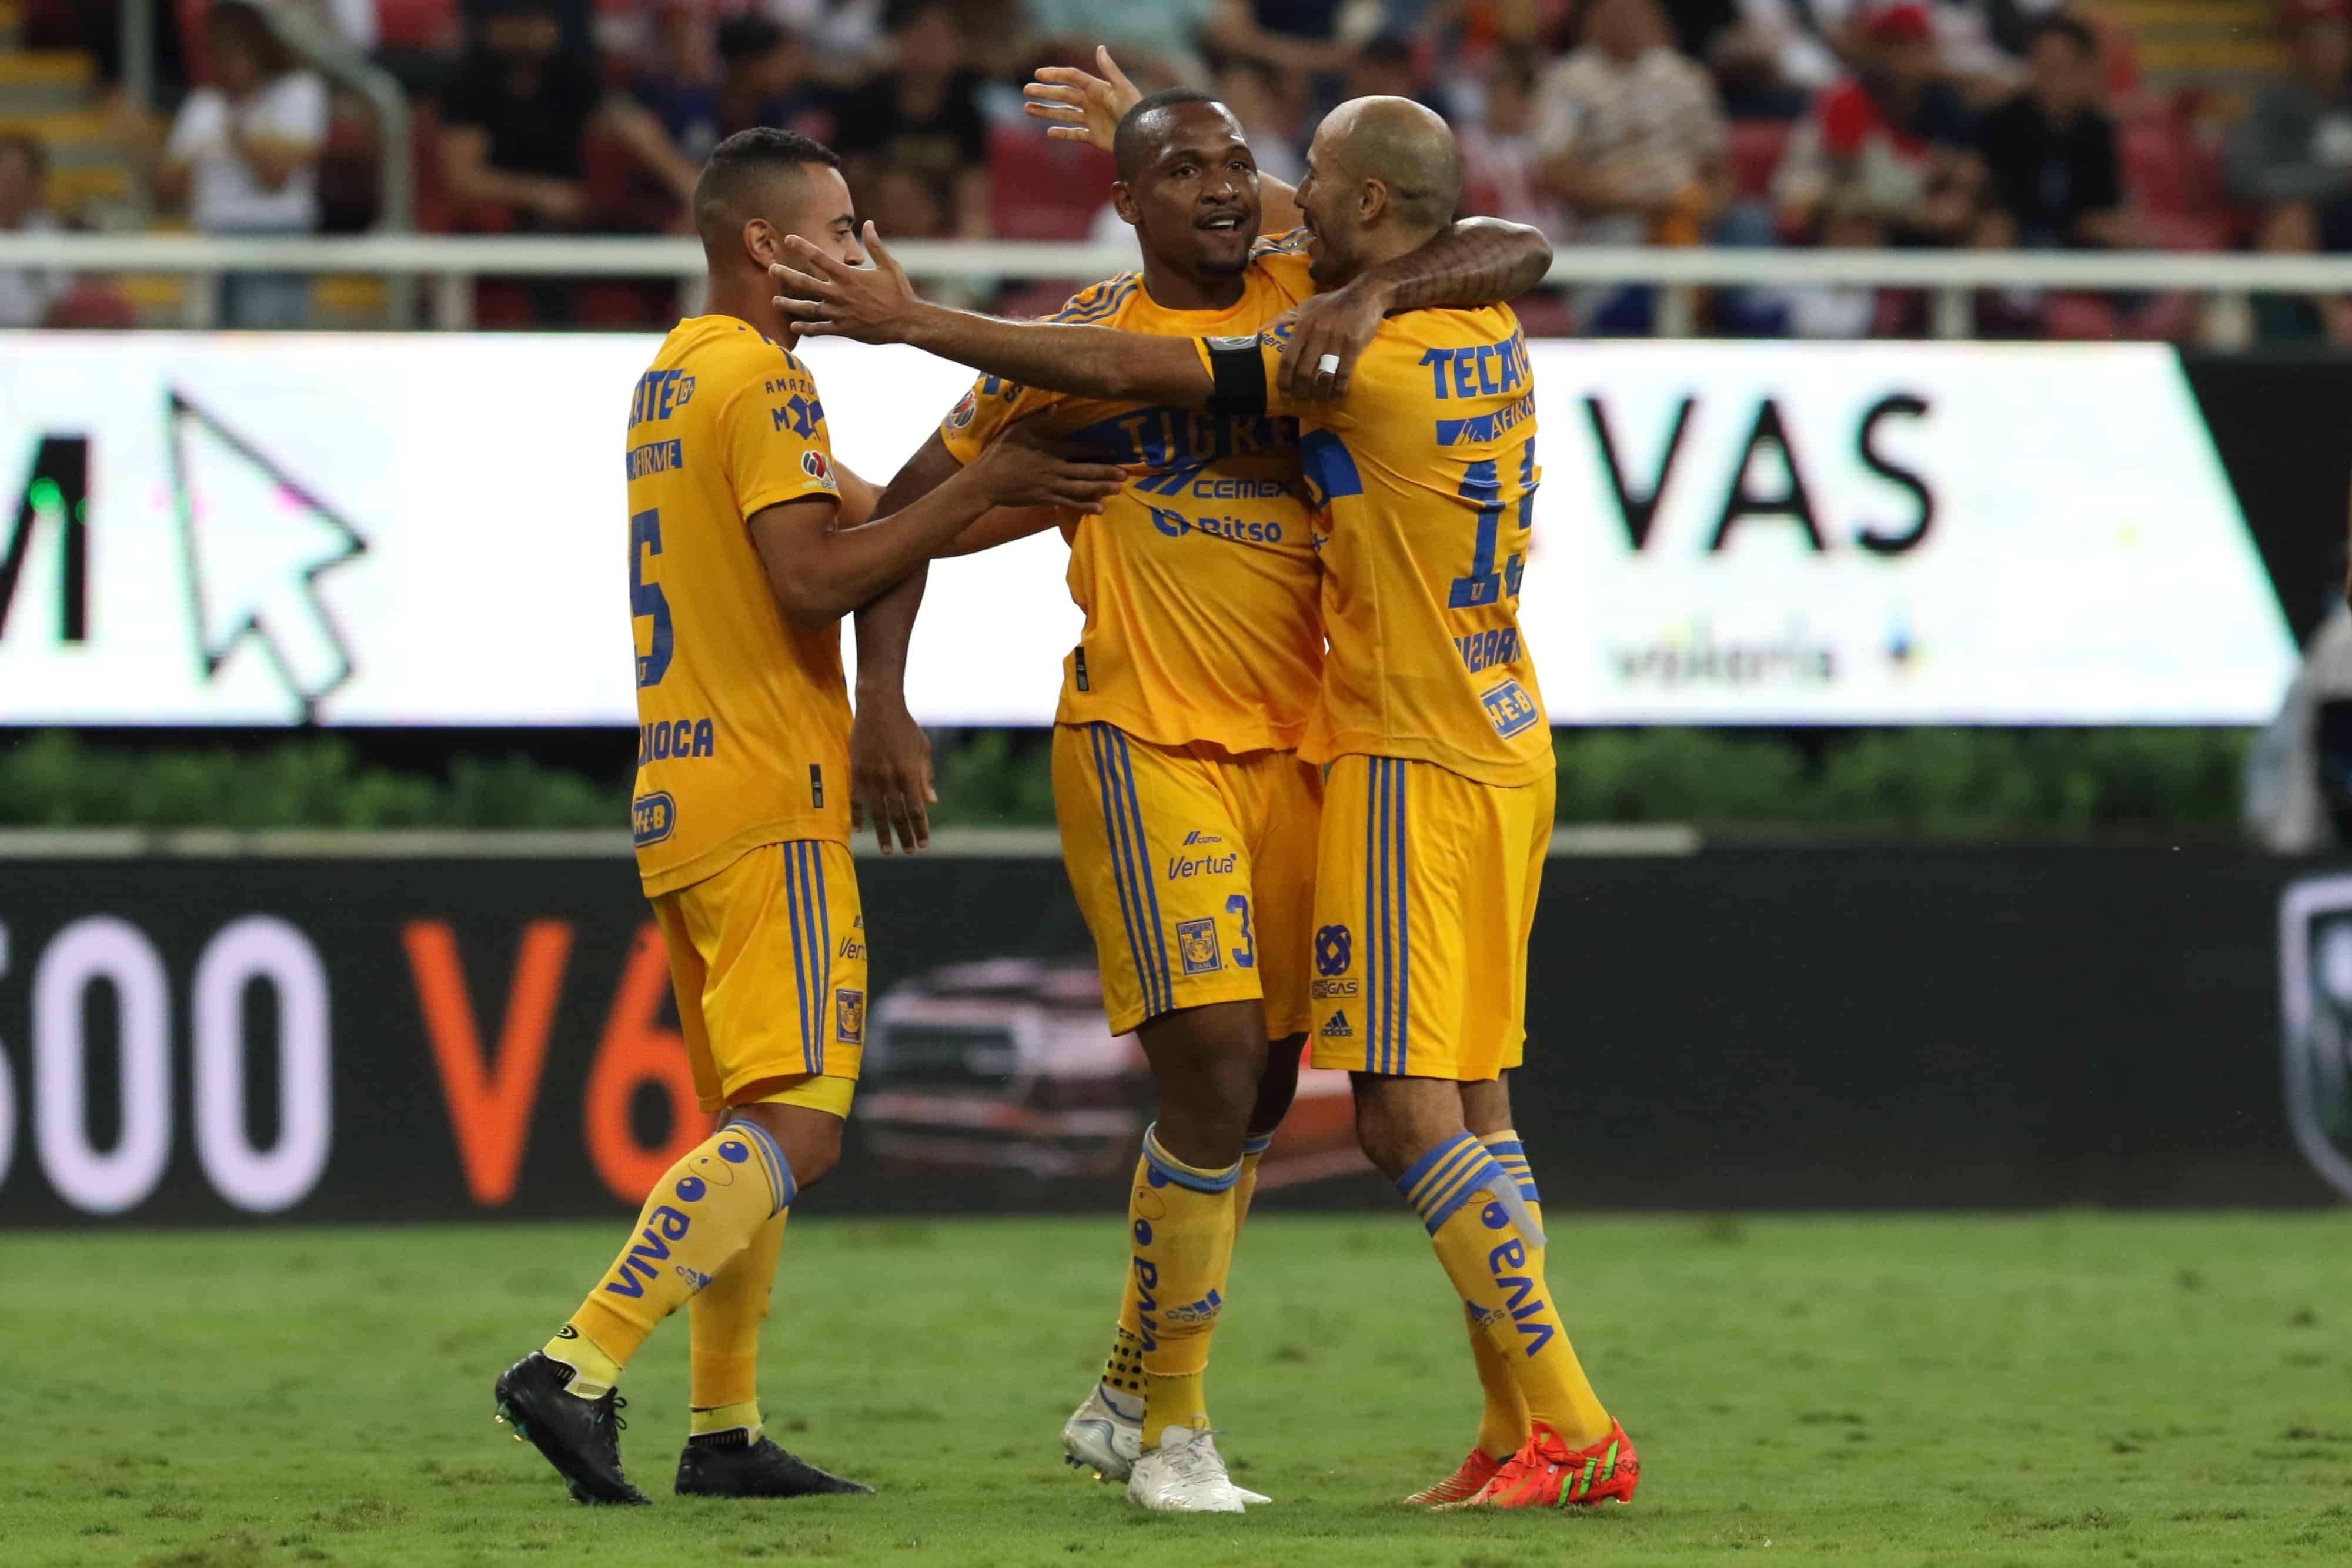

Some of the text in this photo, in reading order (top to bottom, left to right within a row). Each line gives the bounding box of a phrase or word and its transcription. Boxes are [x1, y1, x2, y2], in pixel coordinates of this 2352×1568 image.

[630, 507, 674, 689] 5
[1225, 894, 1254, 968] 3
[0, 915, 332, 1215] 00
